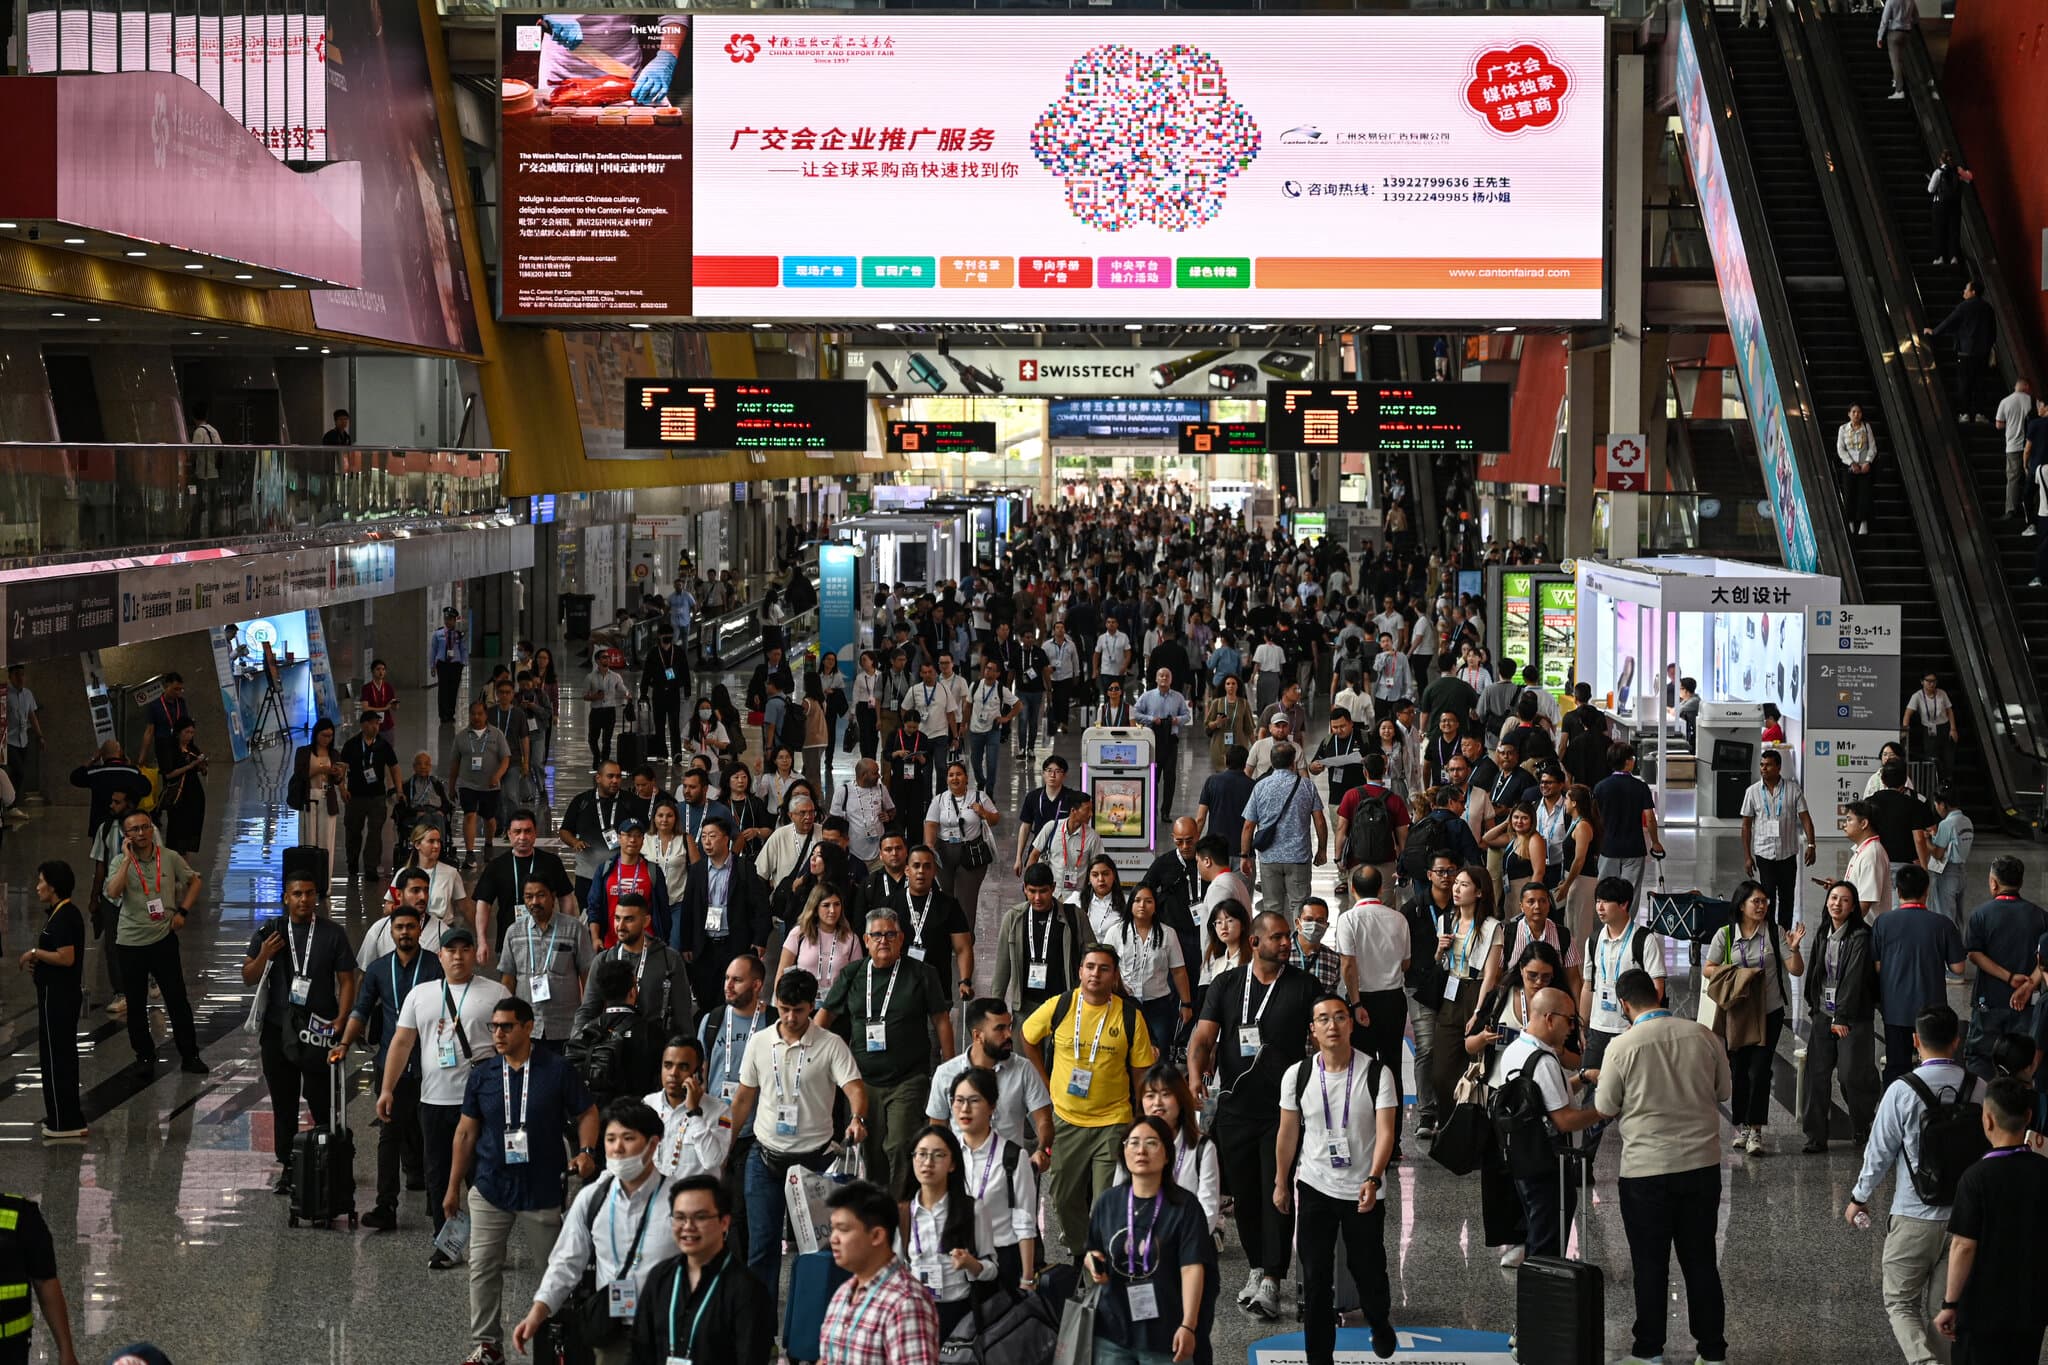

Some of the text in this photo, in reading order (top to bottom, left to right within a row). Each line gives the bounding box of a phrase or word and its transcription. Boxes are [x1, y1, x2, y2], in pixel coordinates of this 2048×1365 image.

[630, 25, 681, 34] THE WESTIN
[1487, 57, 1541, 82] 广交会
[1482, 74, 1556, 104] 媒体独家
[1497, 96, 1552, 121] 运营商
[730, 126, 996, 151] 广交会企业推广服务
[1383, 177, 1511, 188] 13922799636 王先生
[519, 195, 640, 204] Indulge in authentic Chinese culinary
[1383, 192, 1511, 203] 13922249985 杨小姐
[519, 207, 546, 215] delights
[547, 207, 576, 215] adjacent
[636, 207, 669, 215] Complex.
[576, 255, 595, 263] please
[796, 265, 844, 276] 现场广告
[952, 260, 1001, 270] 专刊名录
[1032, 260, 1080, 271] 导向手册
[1111, 260, 1159, 271] 中央平台
[965, 271, 988, 283] 广告
[1044, 272, 1068, 283] 广告
[1111, 272, 1159, 283] 推介活动
[1189, 266, 1238, 278] 绿色特装
[1449, 268, 1570, 278] www.cantonfairad.com
[1040, 365, 1135, 378] SWISSTECH
[1409, 405, 1437, 415] FOOD
[1711, 586, 1791, 605] 大创设计
[1839, 610, 1854, 622] 3F
[1854, 625, 1891, 636] 9.3-11.3
[1820, 665, 1835, 677] 2F
[1836, 741, 1856, 750] M1F
[1837, 777, 1851, 789] 1F
